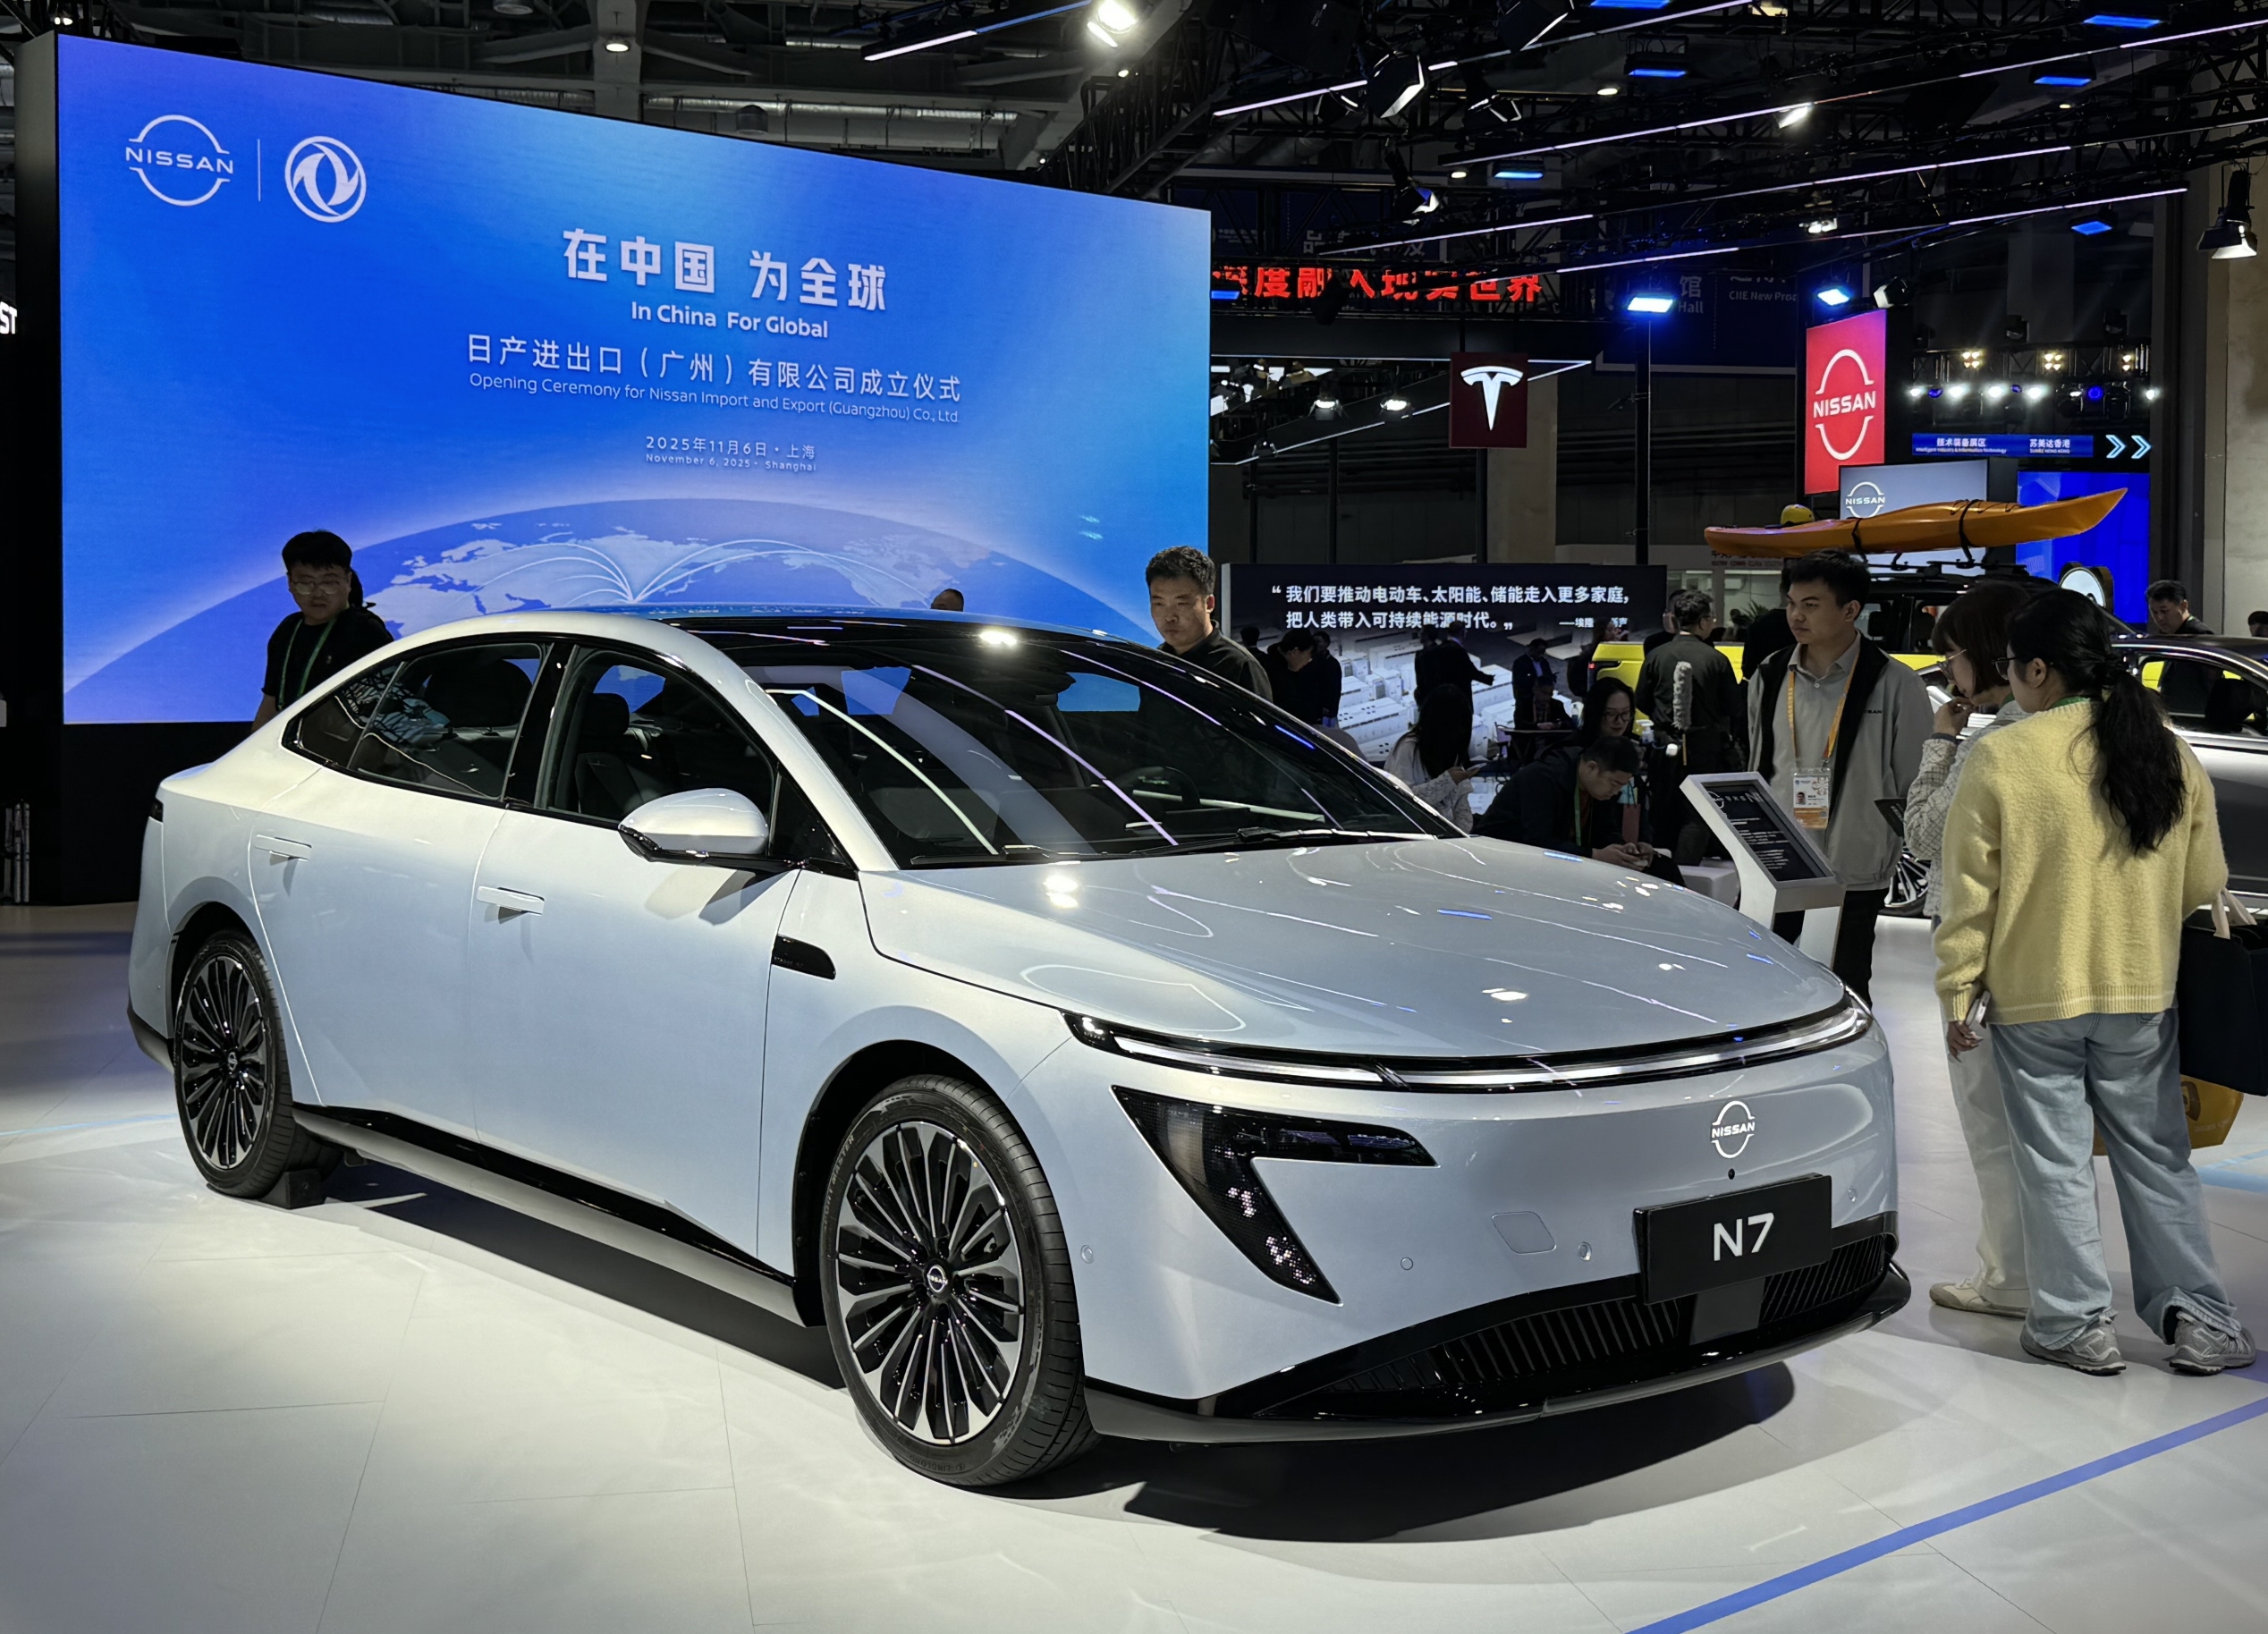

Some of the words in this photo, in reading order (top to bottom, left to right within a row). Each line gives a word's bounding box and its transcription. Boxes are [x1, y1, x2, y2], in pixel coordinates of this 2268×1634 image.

[125, 146, 234, 175] NISSAN
[563, 227, 715, 293] 在中国
[749, 250, 886, 311] 为全球
[631, 301, 652, 321] In
[656, 304, 716, 327] China
[727, 311, 761, 331] For
[766, 316, 828, 338] Global
[468, 334, 961, 402] 日产进出口（广州）有限公司成立仪式
[470, 372, 537, 394] Opening
[541, 378, 621, 400] Ceremony
[624, 385, 646, 399] for
[649, 387, 698, 403] Nissan
[701, 392, 749, 409] Import
[752, 395, 779, 410] and
[783, 398, 825, 414] Export
[828, 401, 910, 420] (Guangzhou)
[1813, 390, 1876, 419] NISSAN
[646, 453, 705, 465] November
[765, 459, 817, 472] Shanghai
[1845, 495, 1886, 504] NISSAN
[1711, 1120, 1756, 1139] NISSAN
[1714, 1212, 1774, 1262] N7
